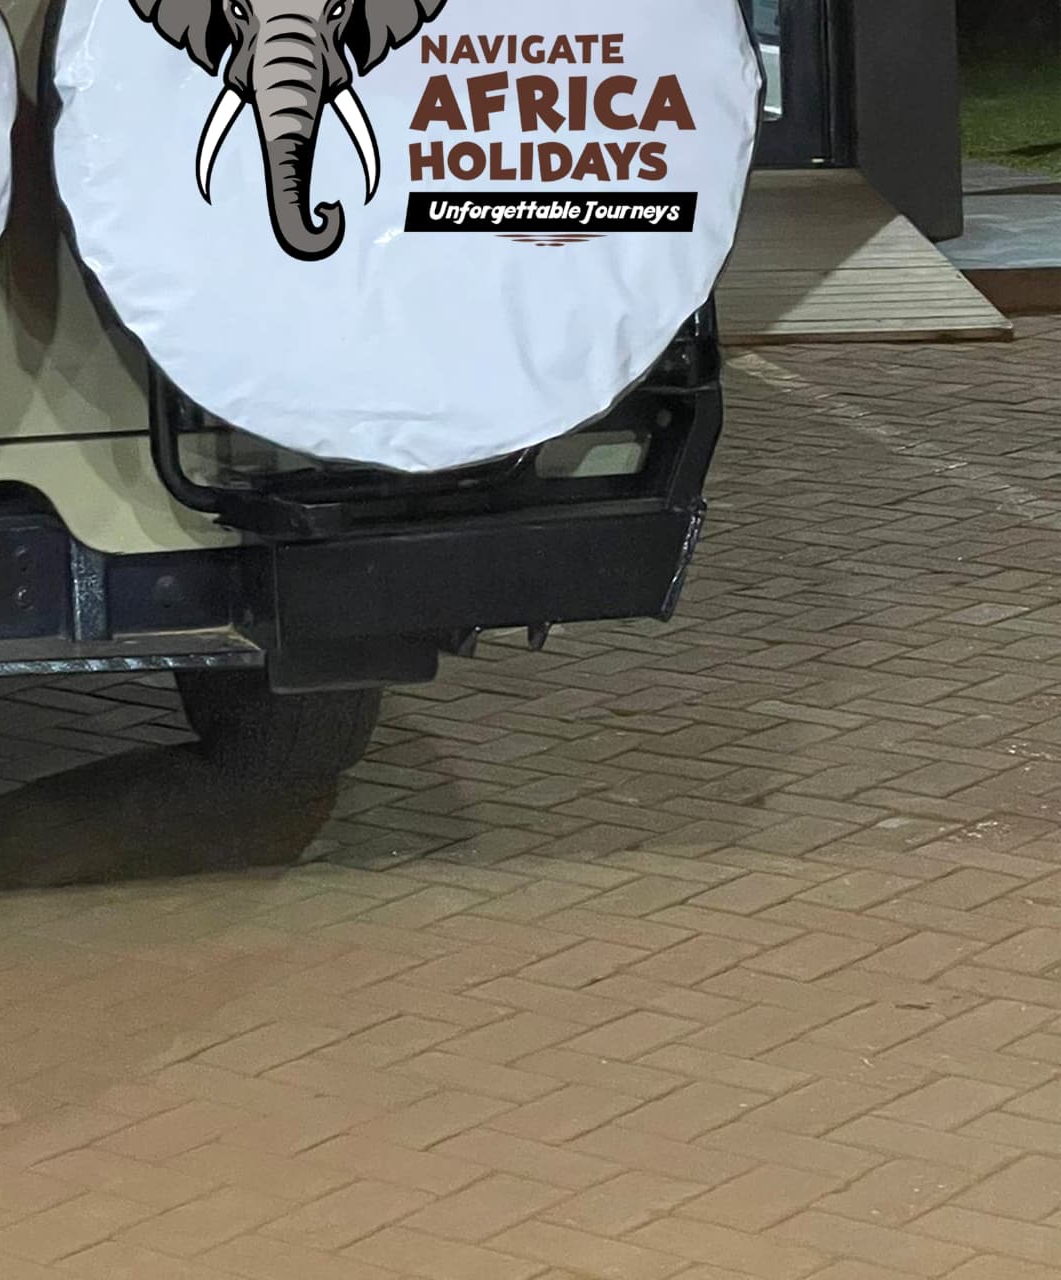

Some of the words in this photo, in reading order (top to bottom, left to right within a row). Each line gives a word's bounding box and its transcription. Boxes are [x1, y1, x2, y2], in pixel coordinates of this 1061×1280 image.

[420, 33, 624, 64] NAVIGATE
[409, 71, 697, 133] AFRICA
[409, 141, 668, 182] HOLIDAYS
[429, 201, 581, 224] Unforgettable
[583, 201, 681, 224] Journeys
